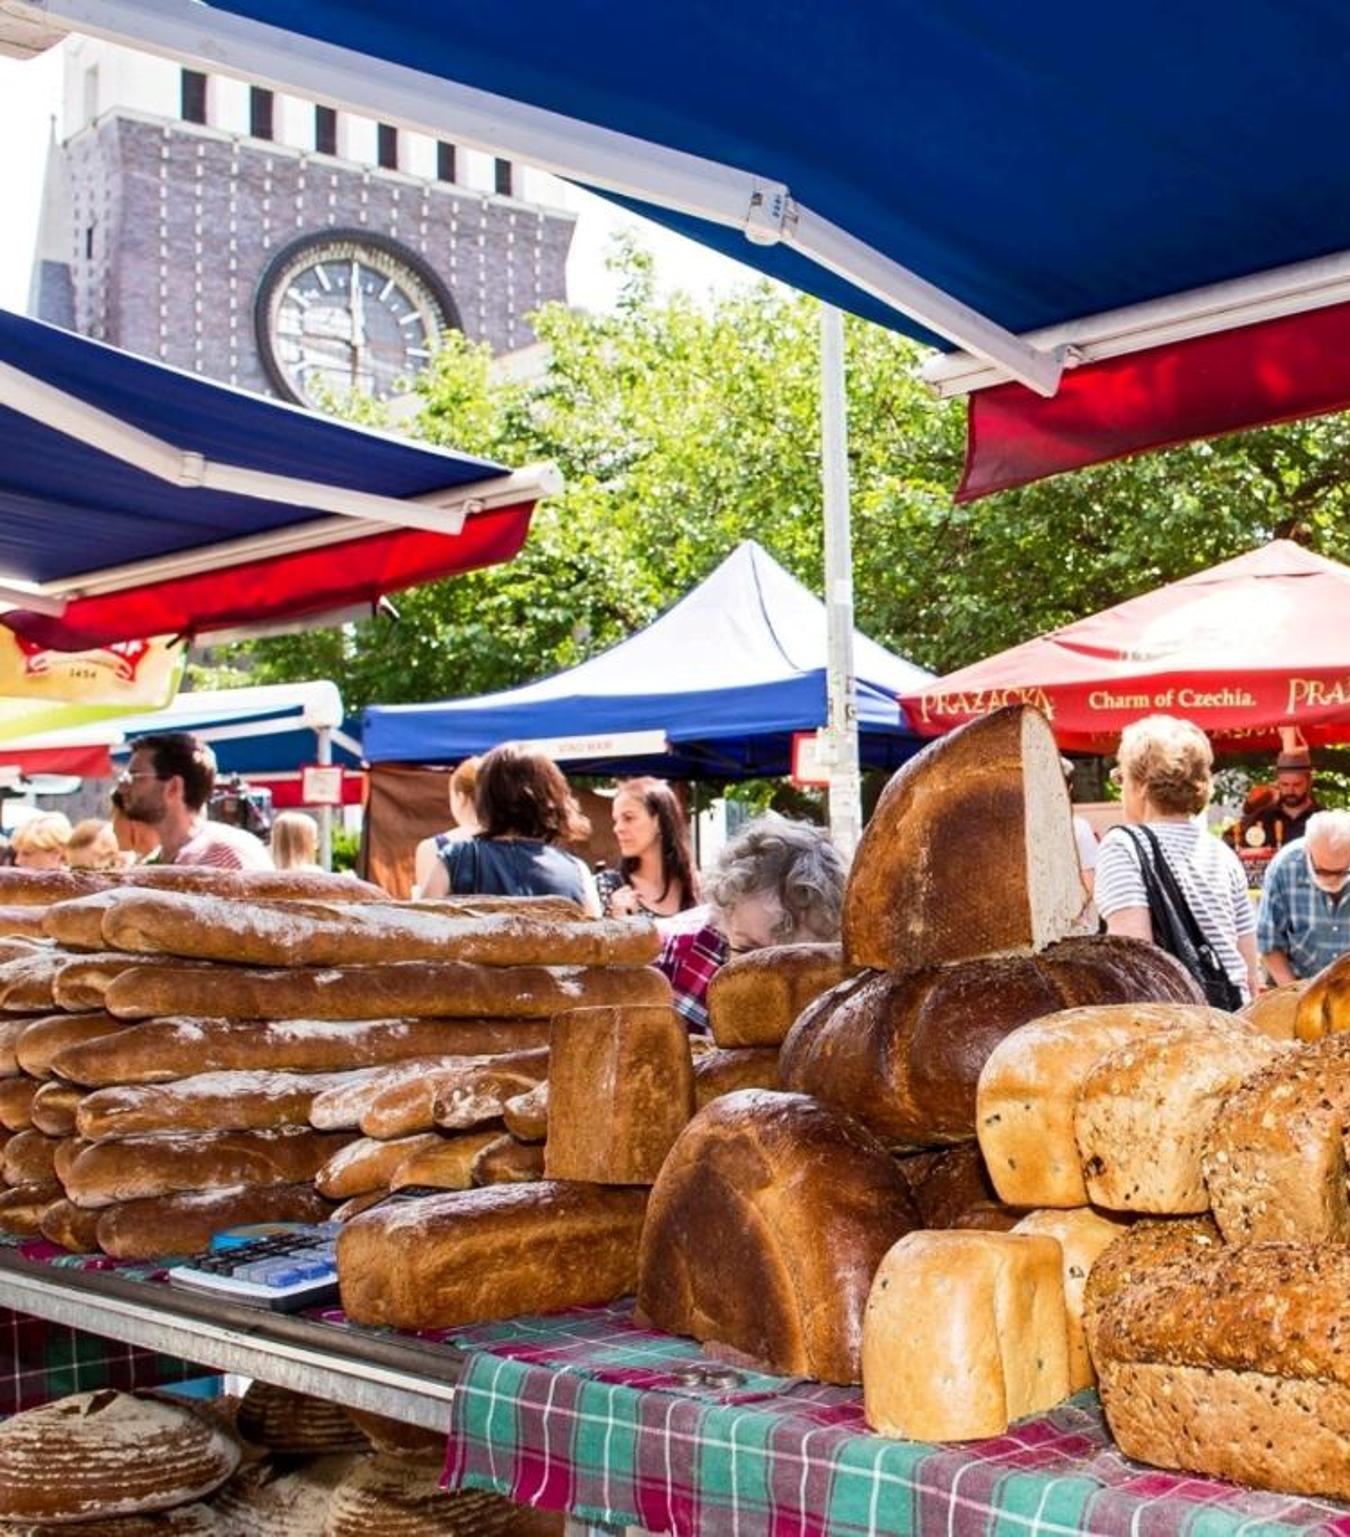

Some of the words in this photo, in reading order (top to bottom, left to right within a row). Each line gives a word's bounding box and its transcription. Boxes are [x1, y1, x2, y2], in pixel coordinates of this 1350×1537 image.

[1089, 691, 1150, 710] Charm
[1154, 688, 1175, 708] of
[1178, 687, 1257, 708] Czechia.
